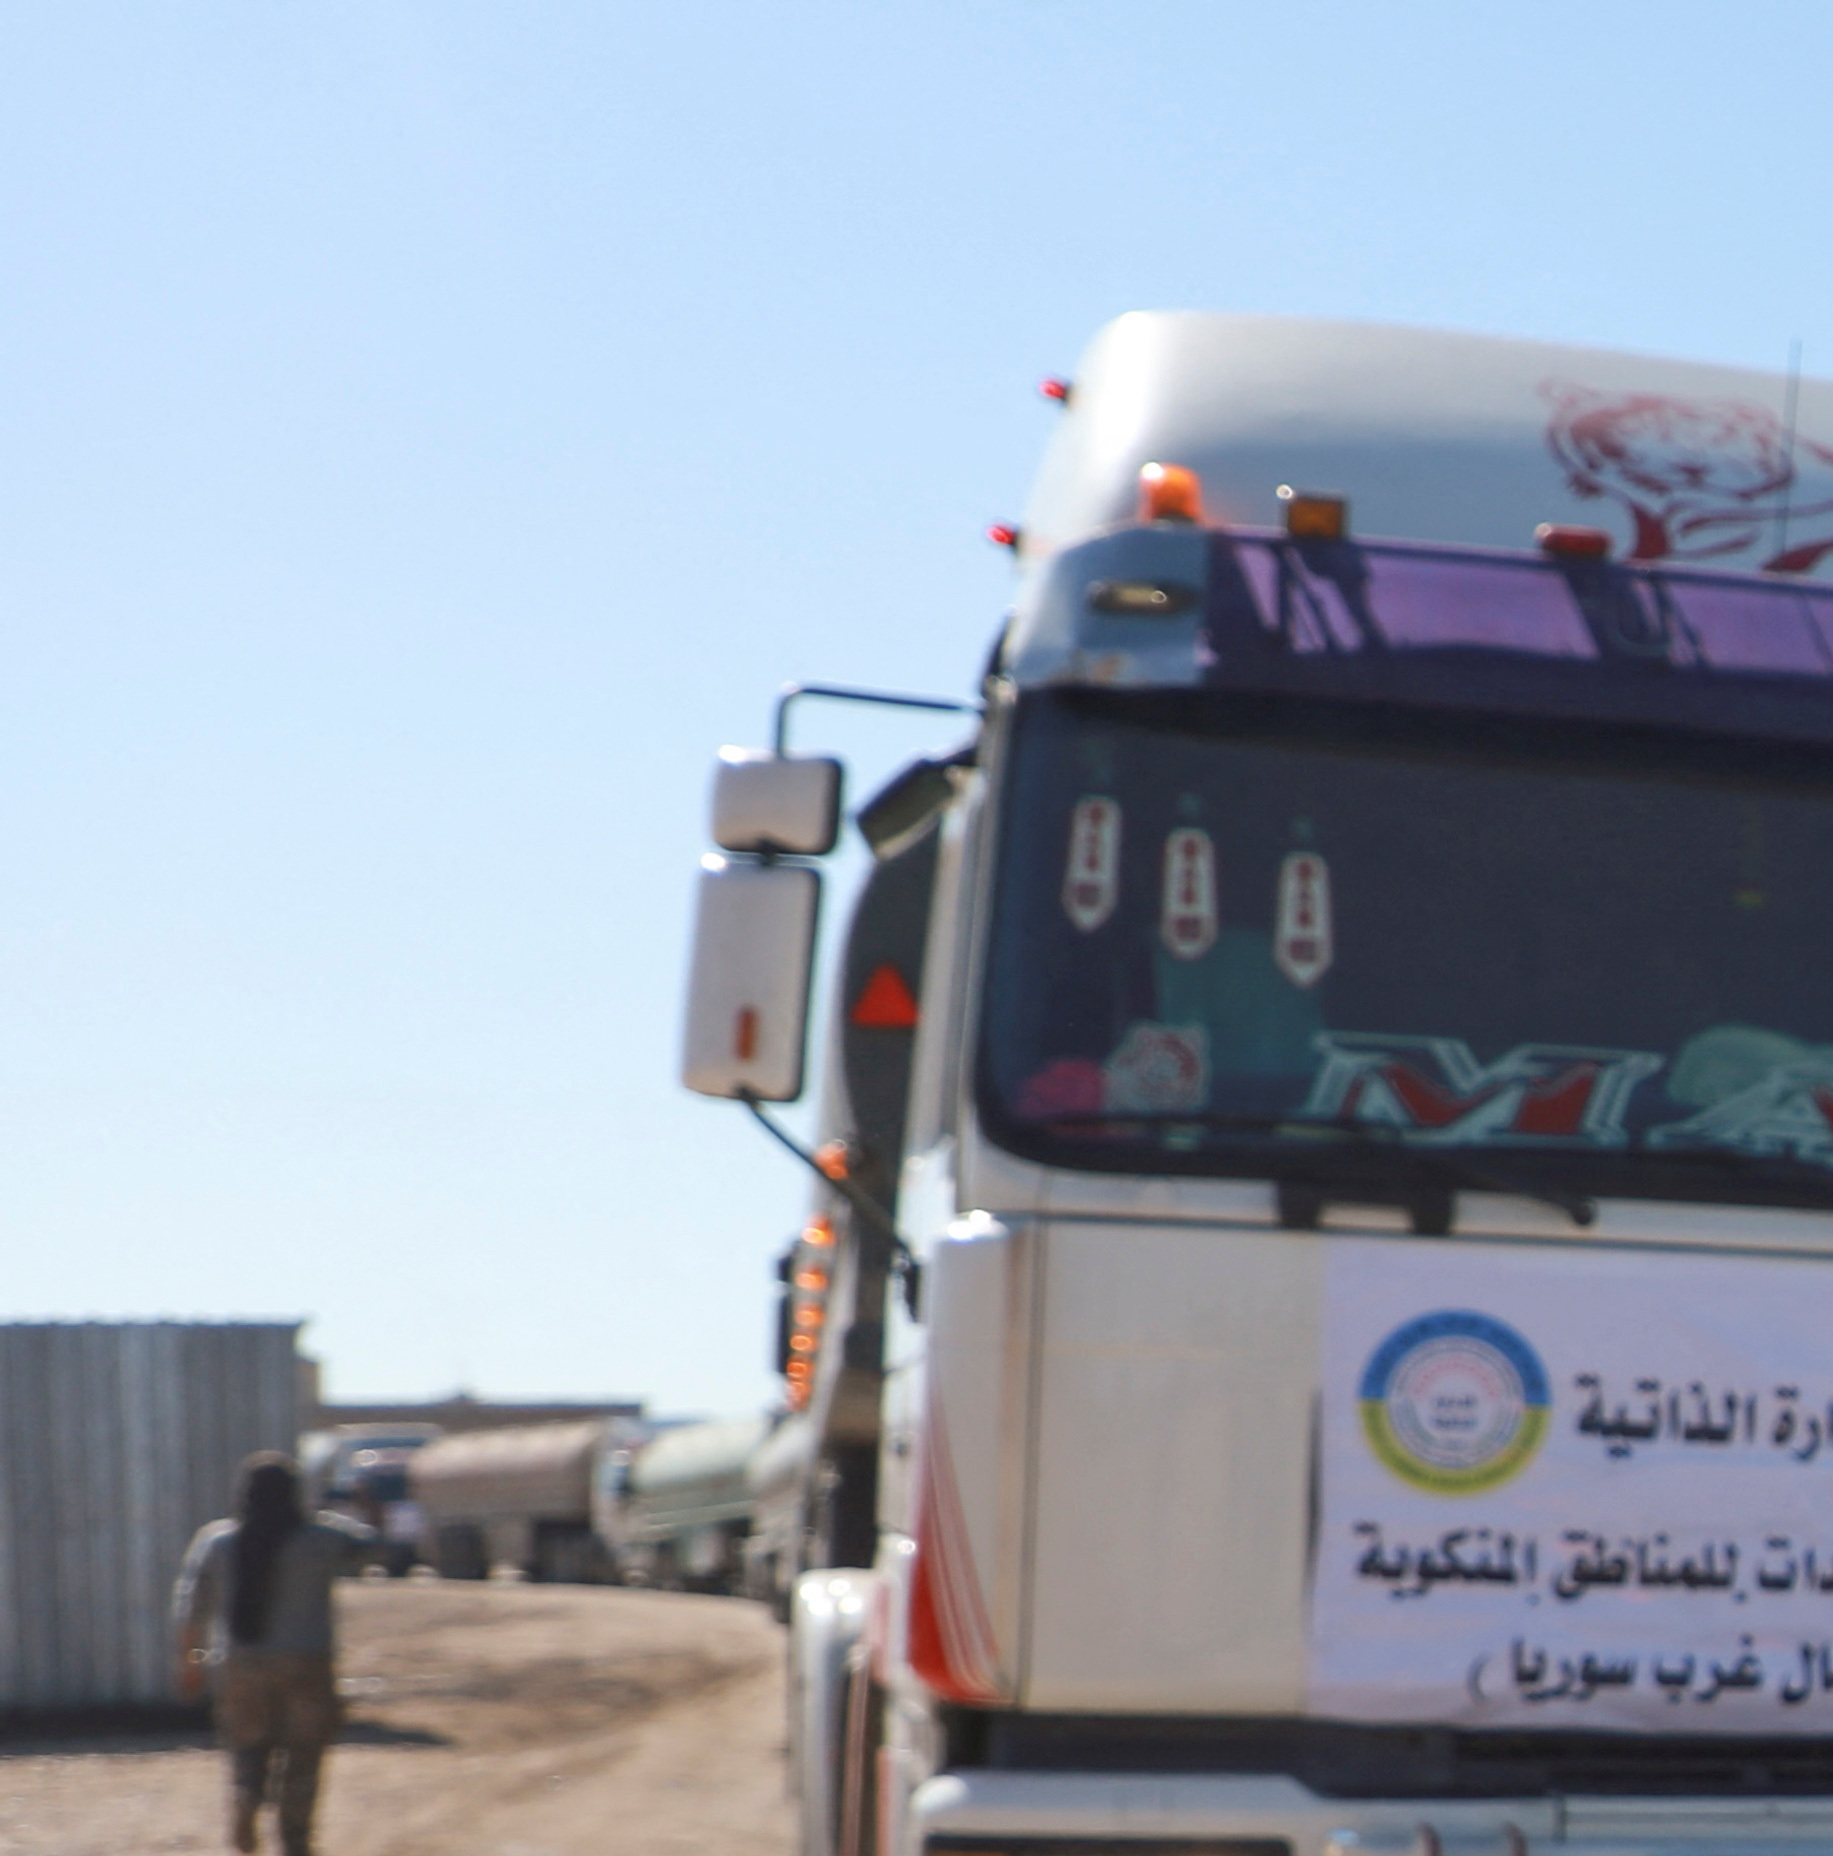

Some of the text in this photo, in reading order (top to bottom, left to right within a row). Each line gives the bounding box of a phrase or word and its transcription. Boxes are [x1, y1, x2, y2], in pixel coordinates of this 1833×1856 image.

[1574, 1371, 1758, 1459] الذاتية
[1354, 1520, 1538, 1601] المنكوبة
[1554, 1529, 1738, 1601] للمناطق
[1654, 1633, 1765, 1704] غرب
